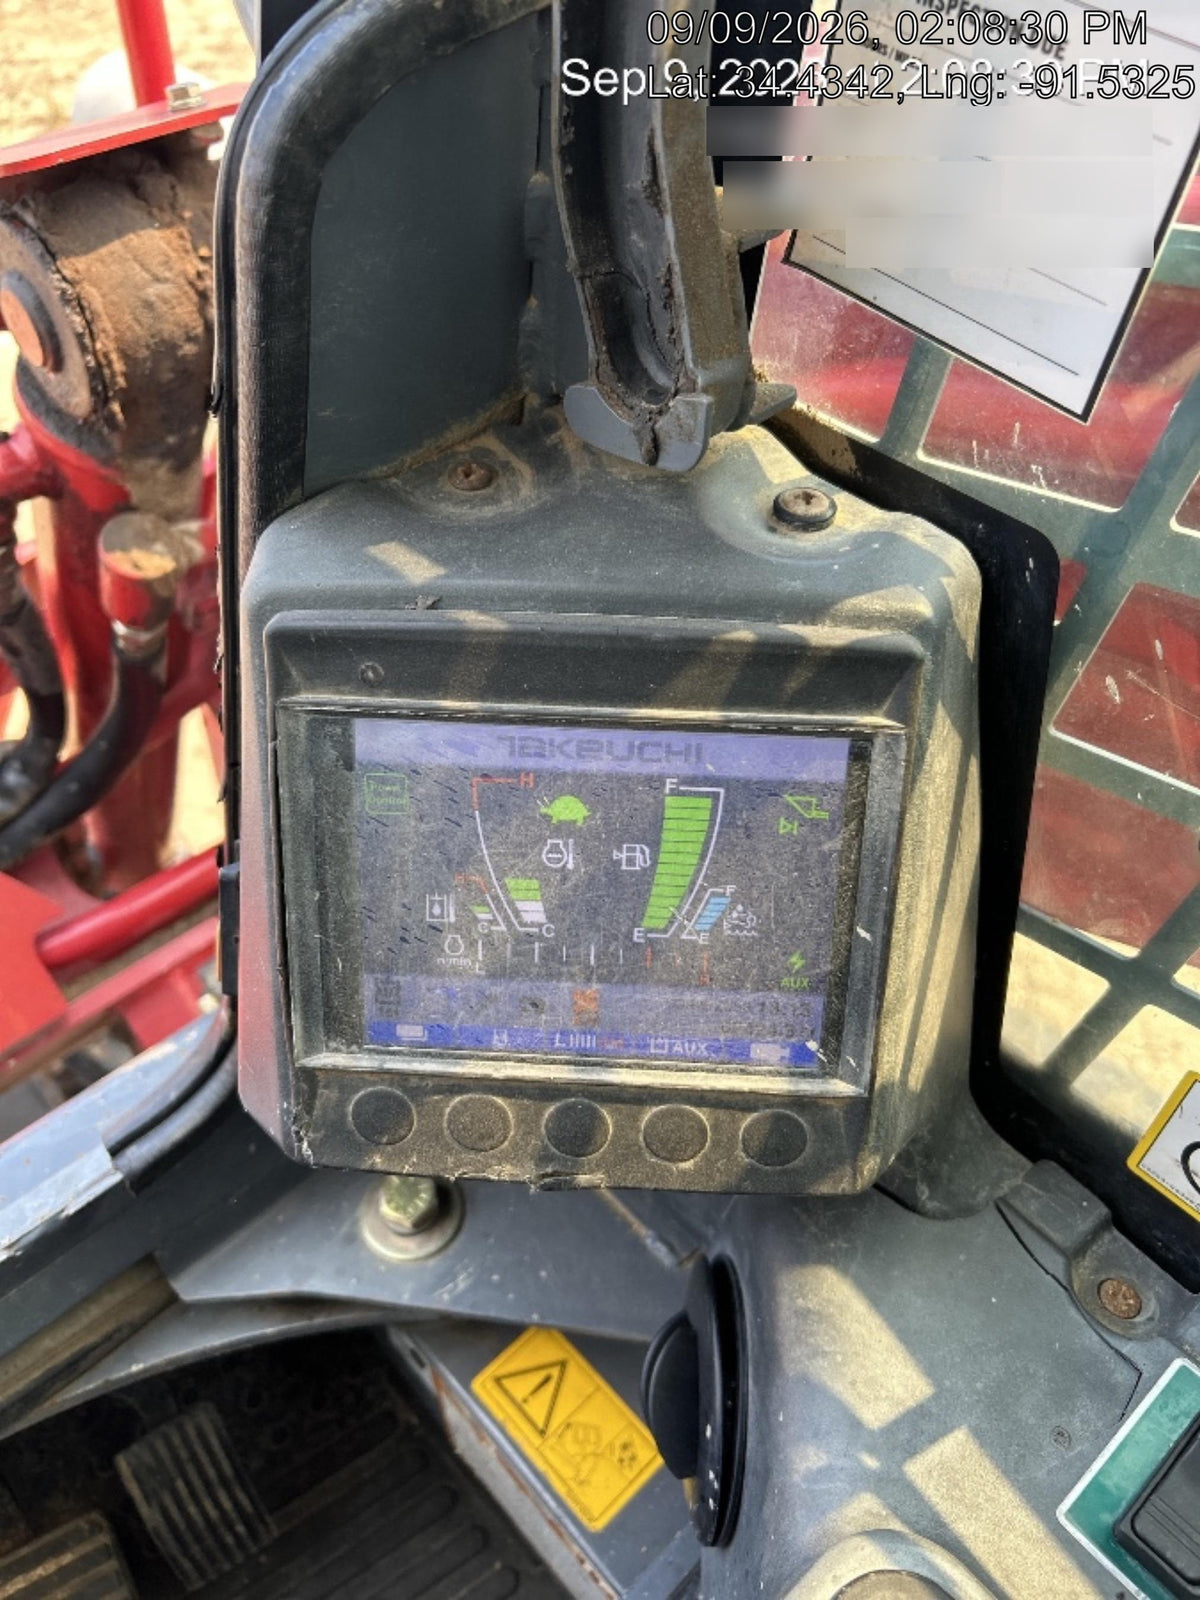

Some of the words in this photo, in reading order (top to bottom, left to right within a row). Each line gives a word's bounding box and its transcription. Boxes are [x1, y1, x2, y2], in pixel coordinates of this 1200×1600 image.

[519, 772, 535, 788] H
[665, 778, 679, 794] F
[726, 885, 737, 897] F
[541, 923, 556, 938] C
[632, 927, 646, 943] E
[780, 977, 811, 990] AUX
